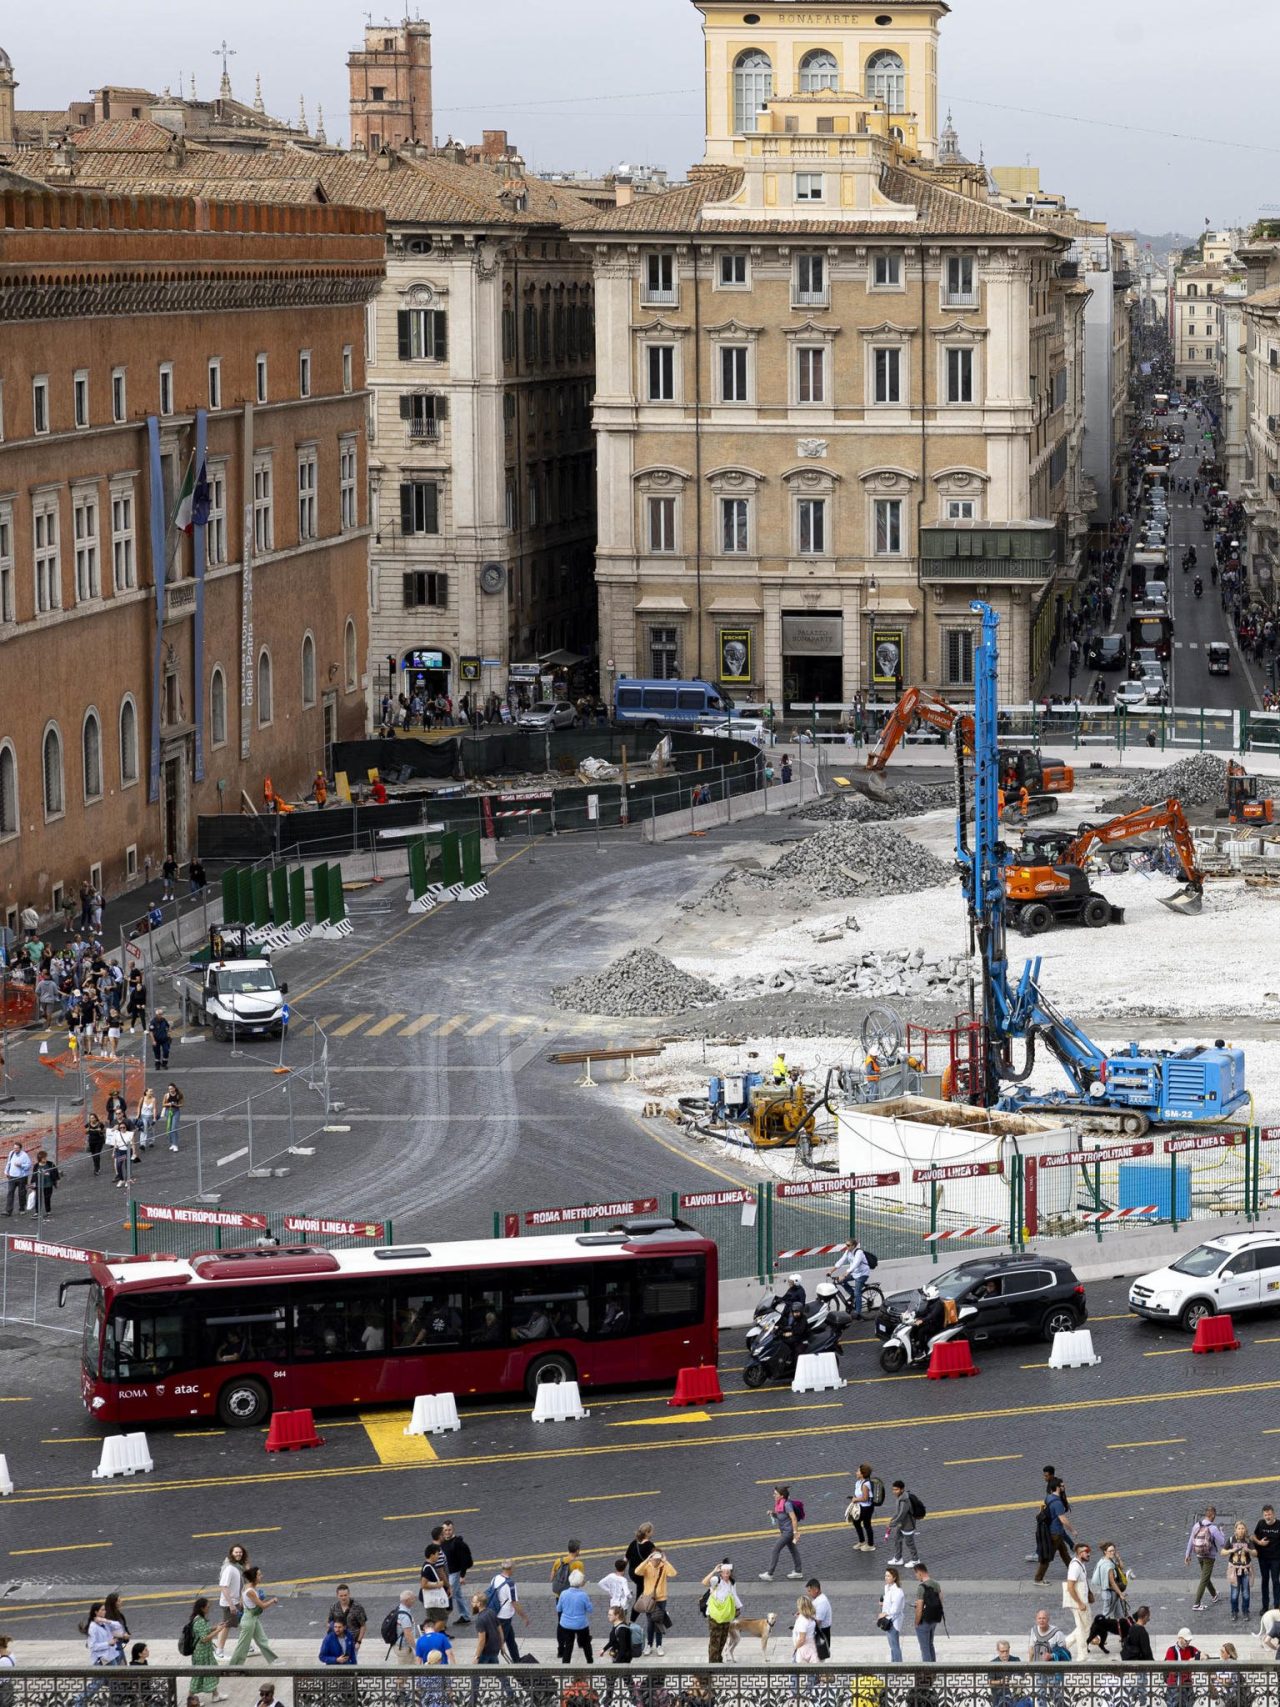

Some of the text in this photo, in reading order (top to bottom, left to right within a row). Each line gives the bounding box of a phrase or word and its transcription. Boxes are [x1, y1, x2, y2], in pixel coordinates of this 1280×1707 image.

[778, 14, 859, 24] BONAPARTE
[246, 670, 254, 706] della
[928, 713, 951, 726] HITACHI
[1164, 1110, 1193, 1118] SM-22
[1168, 1140, 1196, 1152] LAVORI
[1196, 1137, 1218, 1149] LINEA
[1046, 1147, 1134, 1168] ROMA METROPOLITANE
[918, 1169, 946, 1182] LAVORI
[947, 1166, 972, 1178] LINEA
[784, 1176, 878, 1196] ROMA METROPOLITANE
[684, 1190, 752, 1208] LAVORI LINEA C
[146, 1207, 243, 1226] ROMA METROPOLITANE
[532, 1203, 634, 1224] ROMA METROPOLITANE
[288, 1218, 354, 1234] LAVORI LINEA C
[14, 1238, 87, 1262] ROMA METROPOLITANE
[273, 1370, 286, 1378] 844
[118, 1389, 148, 1399] ROMA
[174, 1384, 200, 1394] atac
